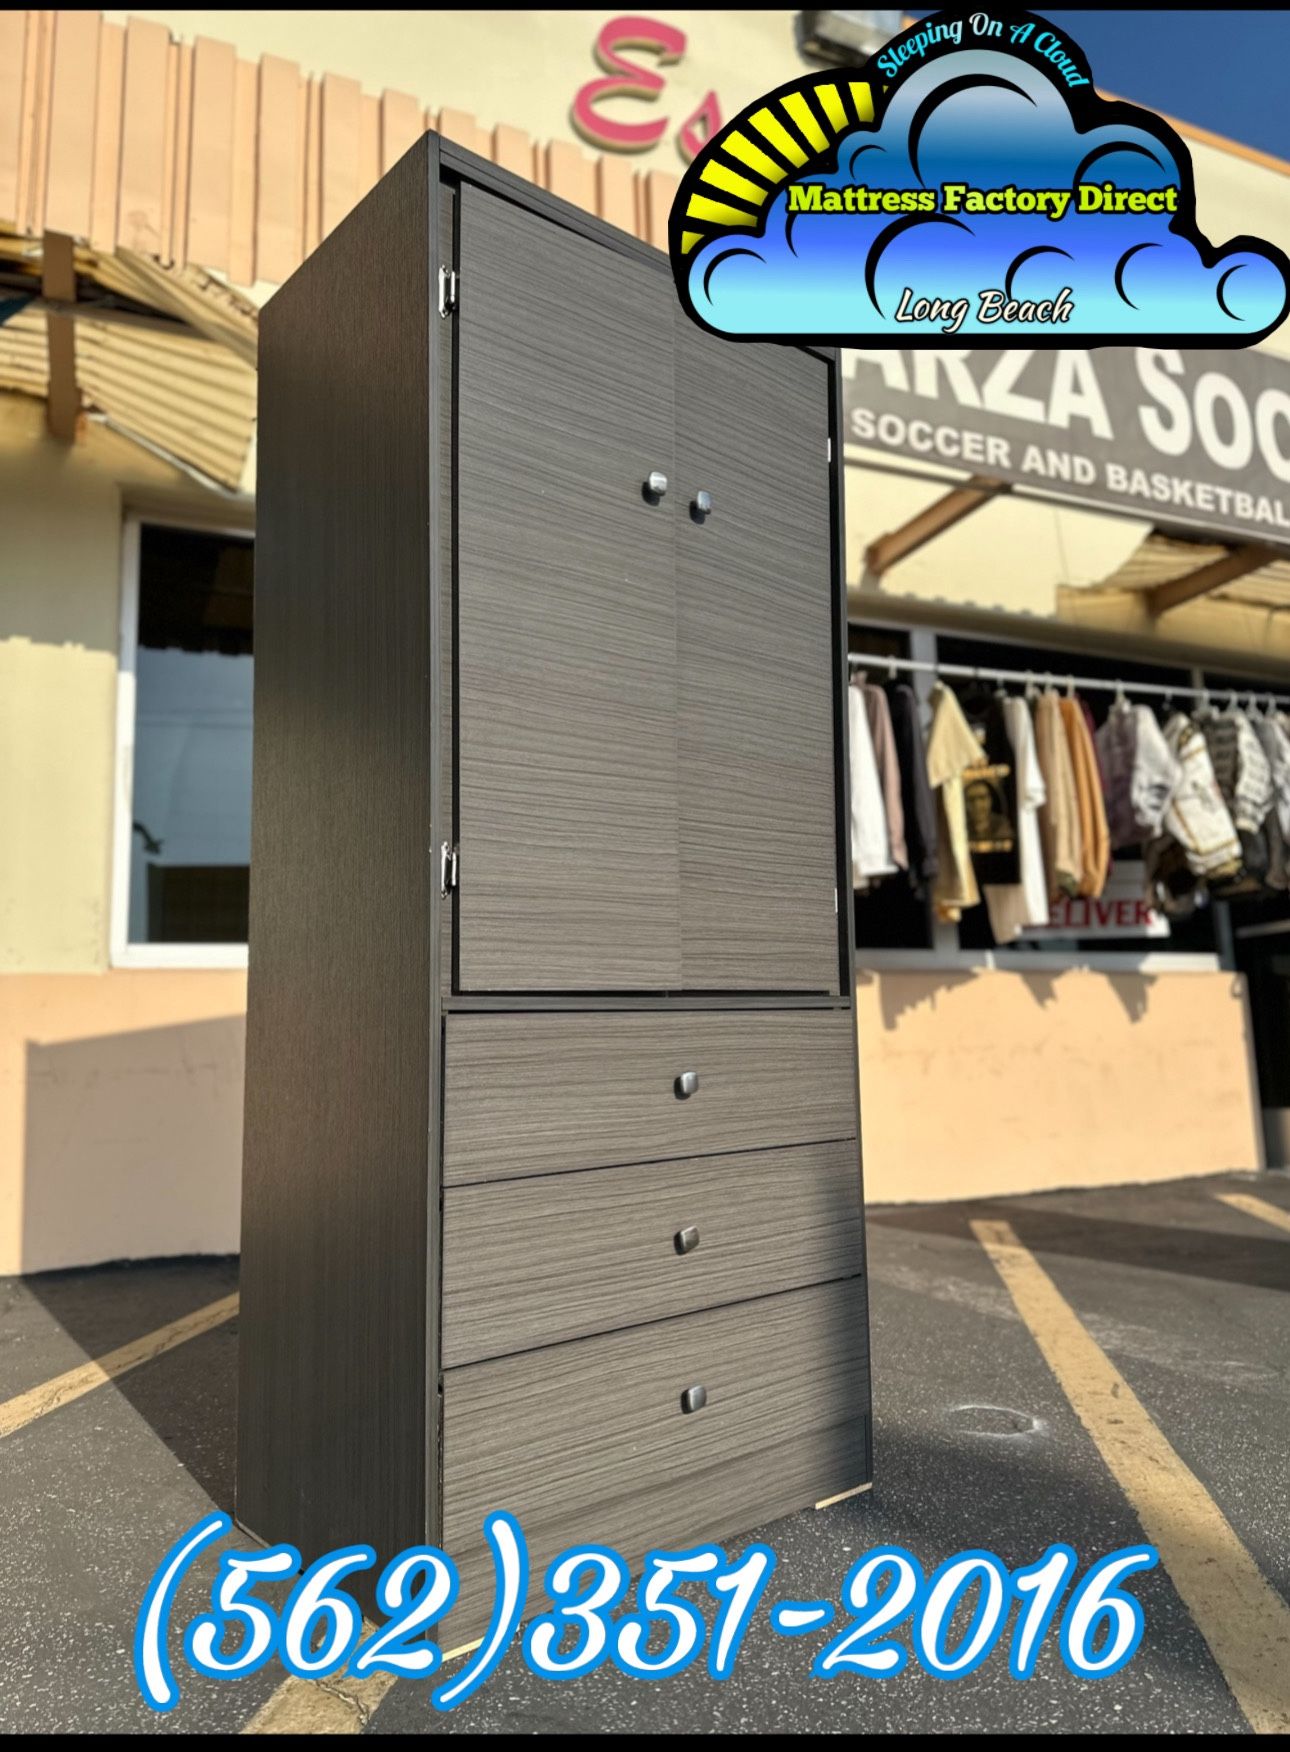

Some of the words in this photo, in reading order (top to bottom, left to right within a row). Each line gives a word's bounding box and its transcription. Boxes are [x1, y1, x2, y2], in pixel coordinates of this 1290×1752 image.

[851, 407, 1013, 468] SOCCER
[1021, 445, 1097, 485] AND
[1105, 463, 1290, 529] BASKETBAL
[1024, 898, 1153, 930] ELIVER
